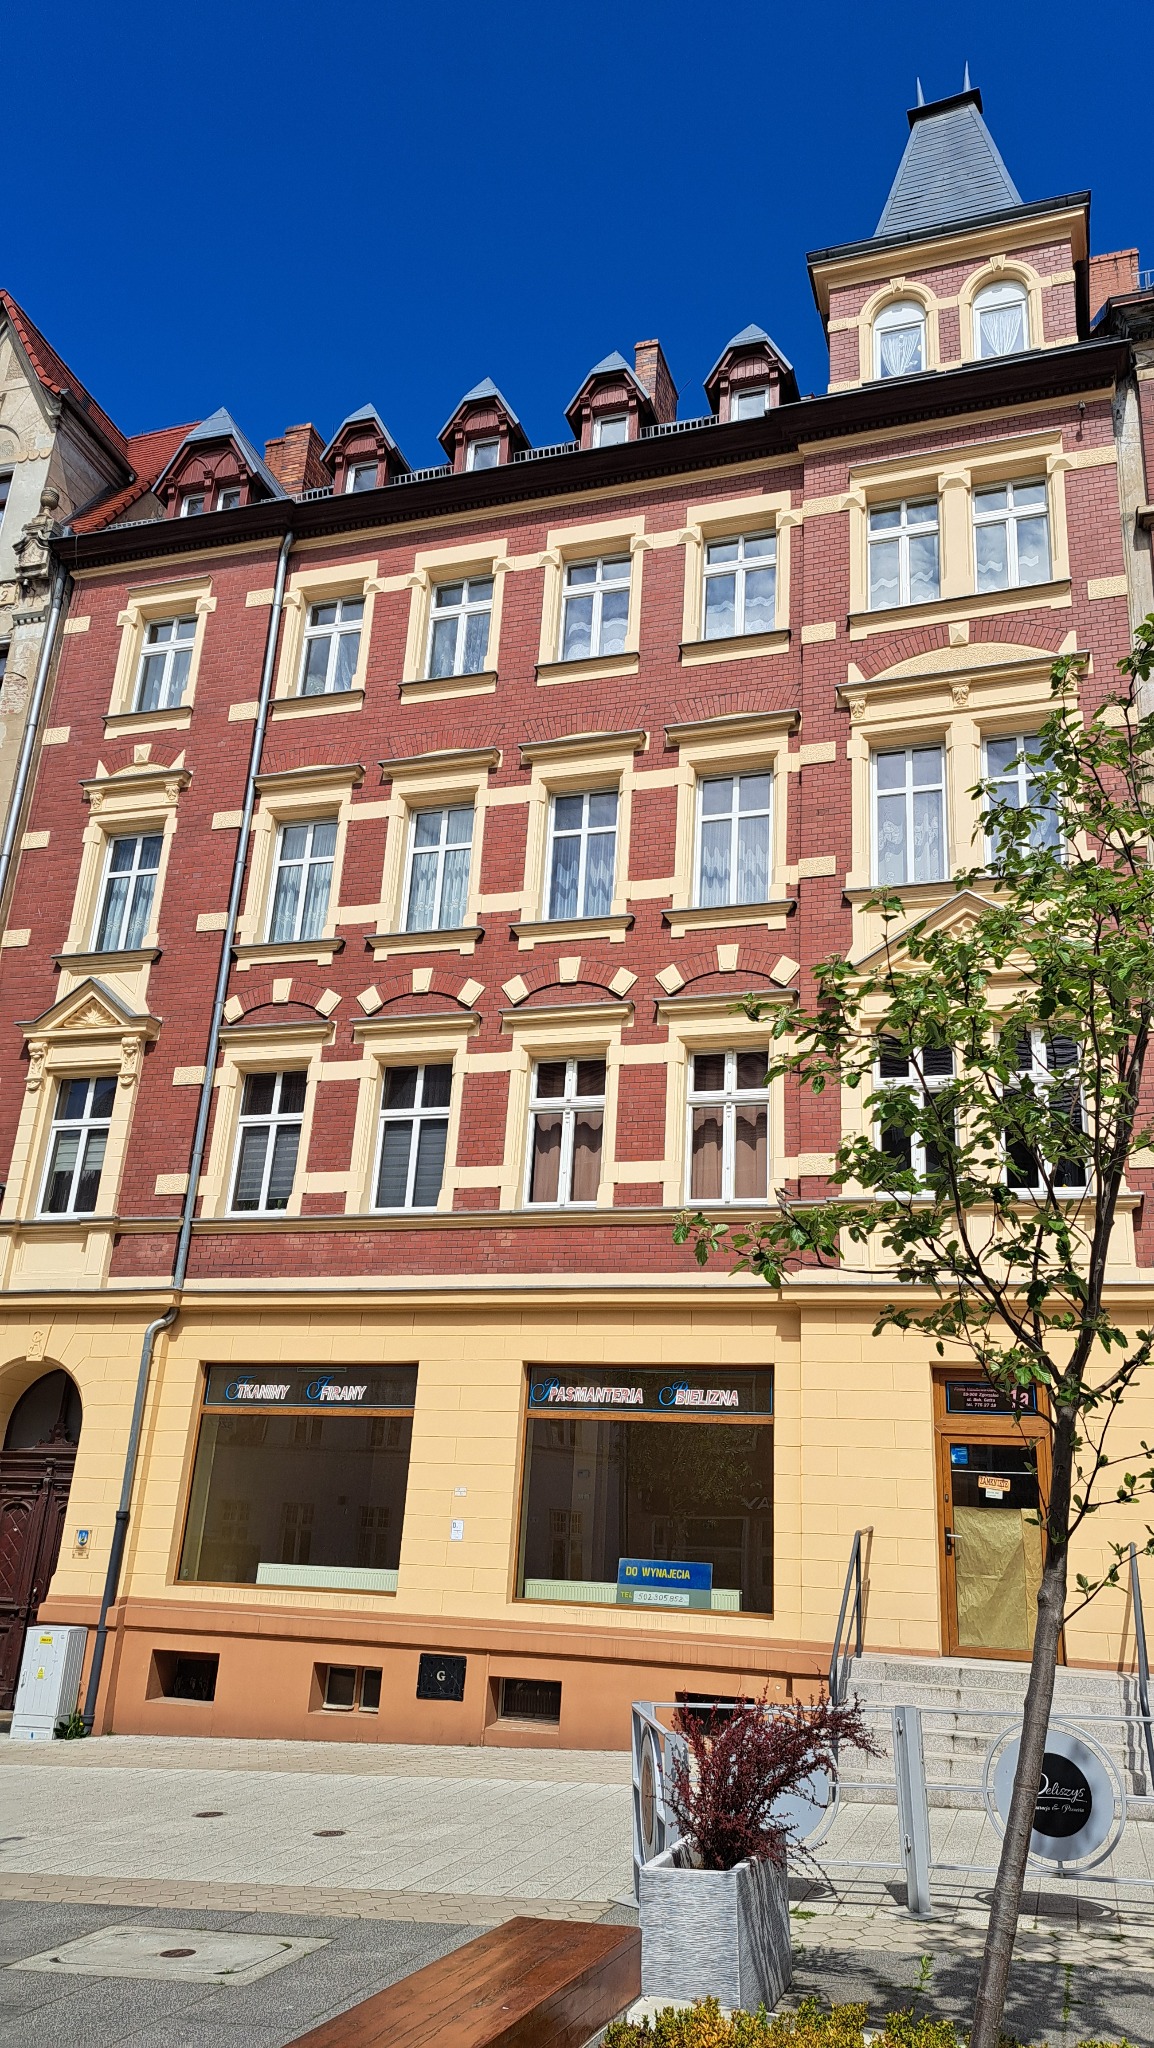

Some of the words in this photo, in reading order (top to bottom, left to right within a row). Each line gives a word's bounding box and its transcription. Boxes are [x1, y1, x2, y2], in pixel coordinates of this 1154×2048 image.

[238, 1384, 291, 1400] TKANINY
[319, 1385, 367, 1401] FIRANY
[548, 1387, 643, 1404] PASMANTERIA
[674, 1390, 739, 1407] BIELIZNA
[625, 1566, 638, 1576] DO
[642, 1567, 691, 1580] WYNAJĘCIA
[436, 1670, 447, 1682] G
